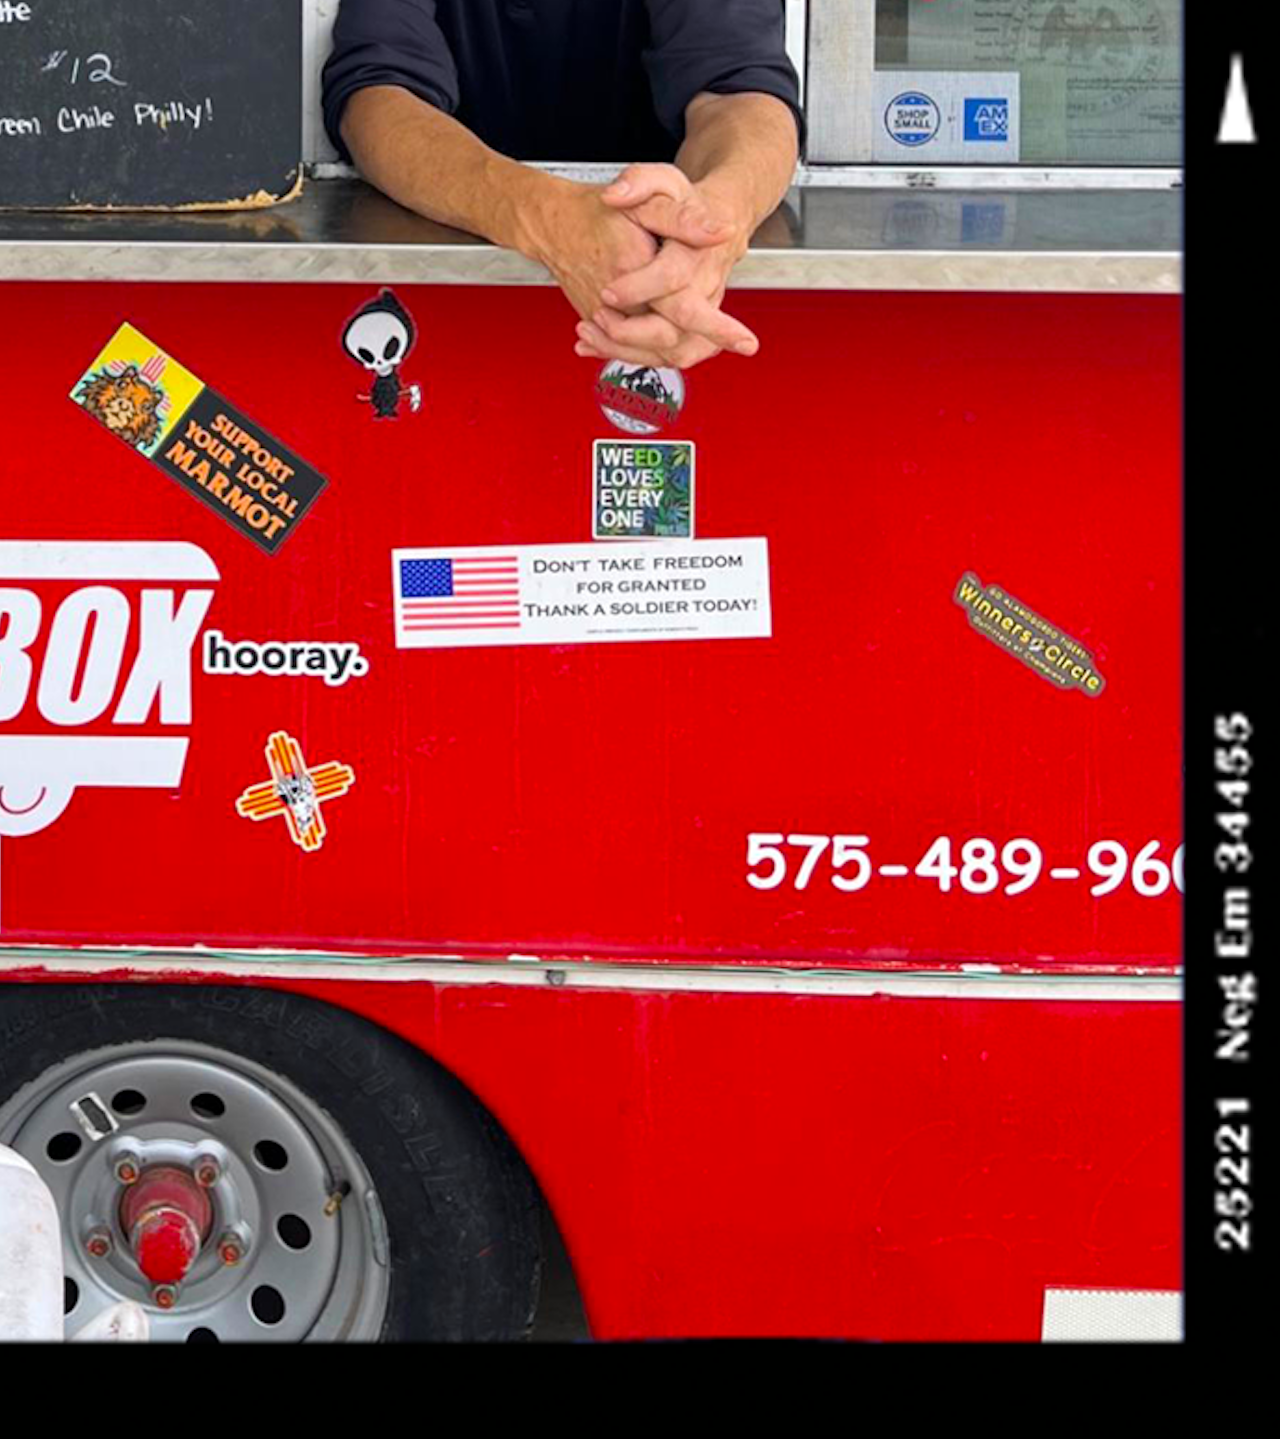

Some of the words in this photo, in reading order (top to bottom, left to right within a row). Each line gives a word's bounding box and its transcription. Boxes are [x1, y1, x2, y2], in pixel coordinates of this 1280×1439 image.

[41, 50, 128, 87] $12
[57, 106, 115, 134] Chile
[134, 98, 214, 129] Philly!
[894, 119, 931, 130] SMALL
[898, 109, 929, 119] SHOP
[211, 414, 295, 484] SUPPORT
[601, 447, 664, 467] WEED
[185, 419, 237, 469] YOUR
[237, 463, 299, 519] LOCAL
[600, 468, 665, 487] LOVES
[165, 439, 287, 540] MARMOT
[600, 488, 666, 507] EVERY
[600, 509, 645, 529] ONE
[533, 559, 590, 574] DON'T
[598, 557, 646, 572] TAKE
[653, 554, 744, 570] FREEDOM
[576, 580, 616, 595] FOR
[618, 578, 707, 593] GRANTED
[524, 602, 588, 618] THANK
[593, 603, 607, 616] A
[610, 600, 689, 616] SOLDIER
[694, 596, 758, 613] TODAY!
[959, 581, 1033, 643] Winners
[1044, 644, 1101, 690] Circle
[208, 637, 364, 679] hooray.
